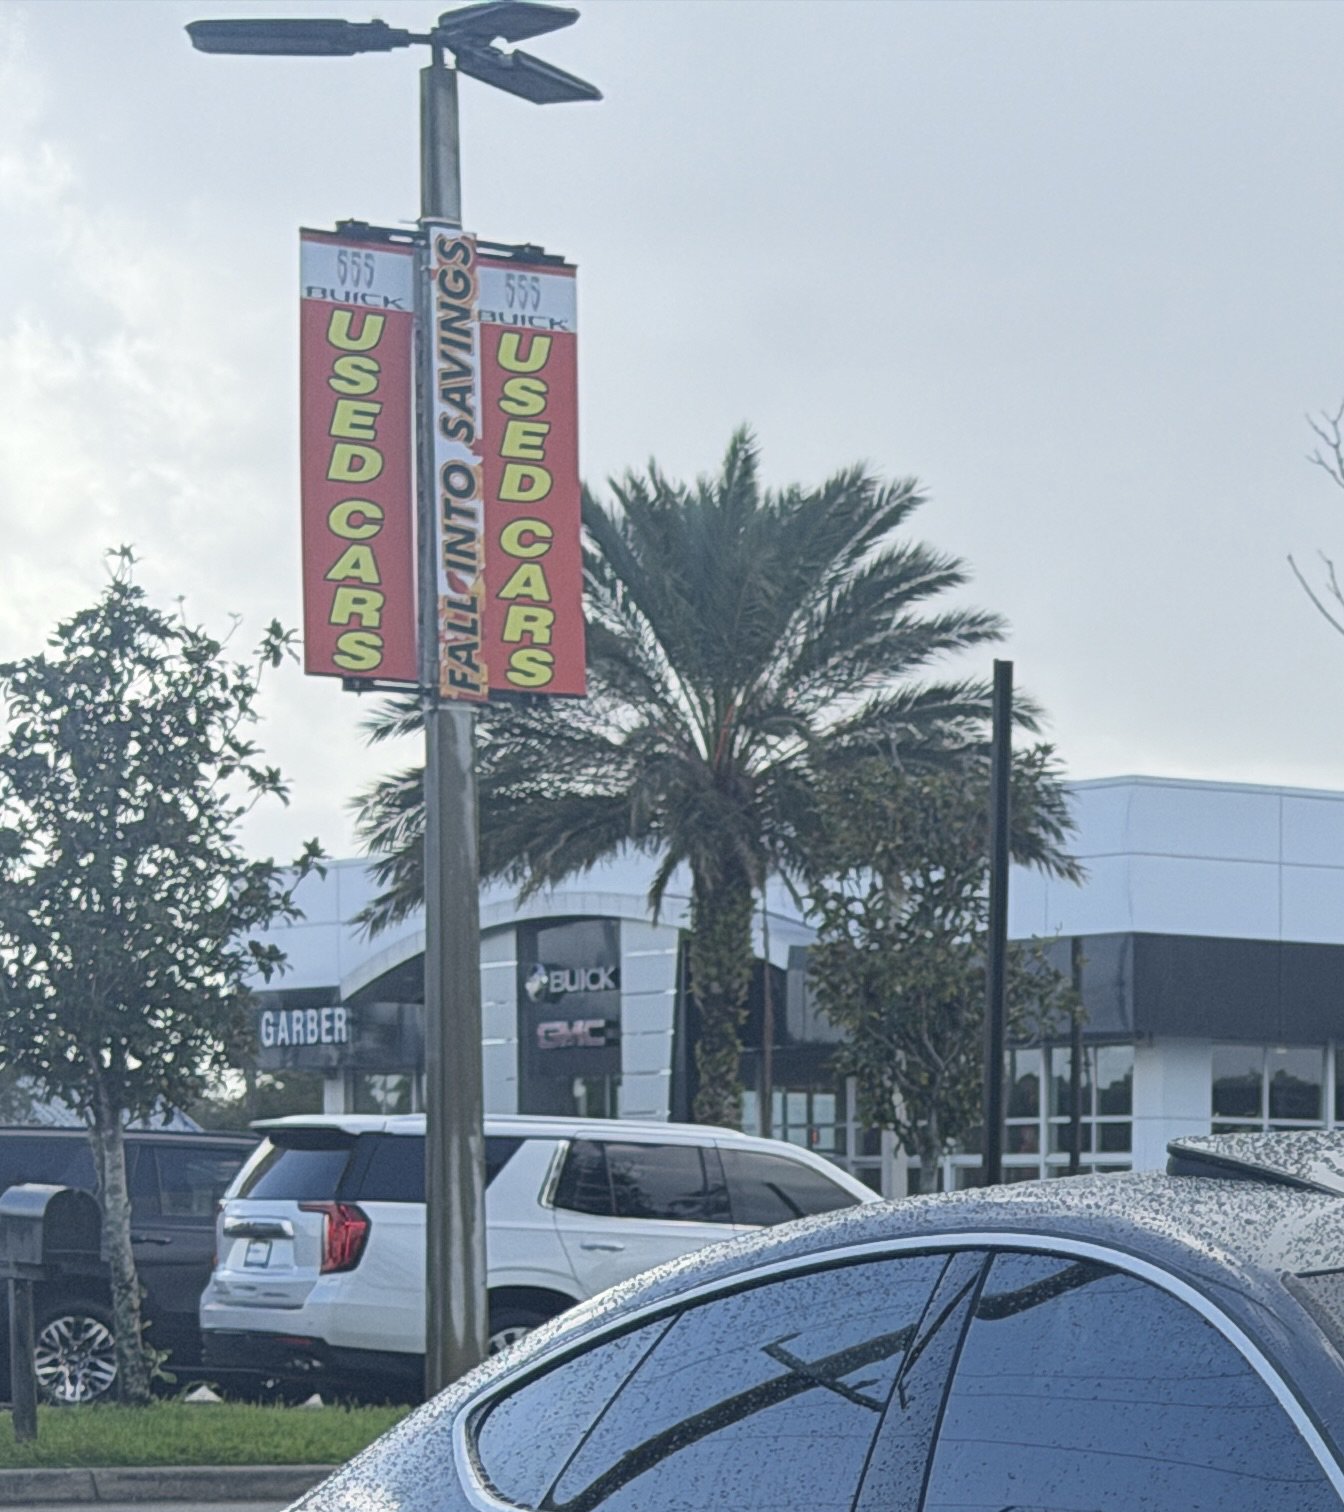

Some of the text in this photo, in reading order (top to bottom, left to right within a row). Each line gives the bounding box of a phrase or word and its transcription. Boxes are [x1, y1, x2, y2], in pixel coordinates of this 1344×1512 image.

[306, 286, 404, 309] BUICK
[479, 310, 568, 331] BUICK
[437, 235, 482, 694] FALL INTO SAVINGS
[324, 309, 386, 672] USED CARS
[496, 331, 556, 689] USED CARS
[550, 966, 618, 995] BUICK
[261, 1007, 348, 1047] GARBER
[537, 1019, 606, 1049] GMC
